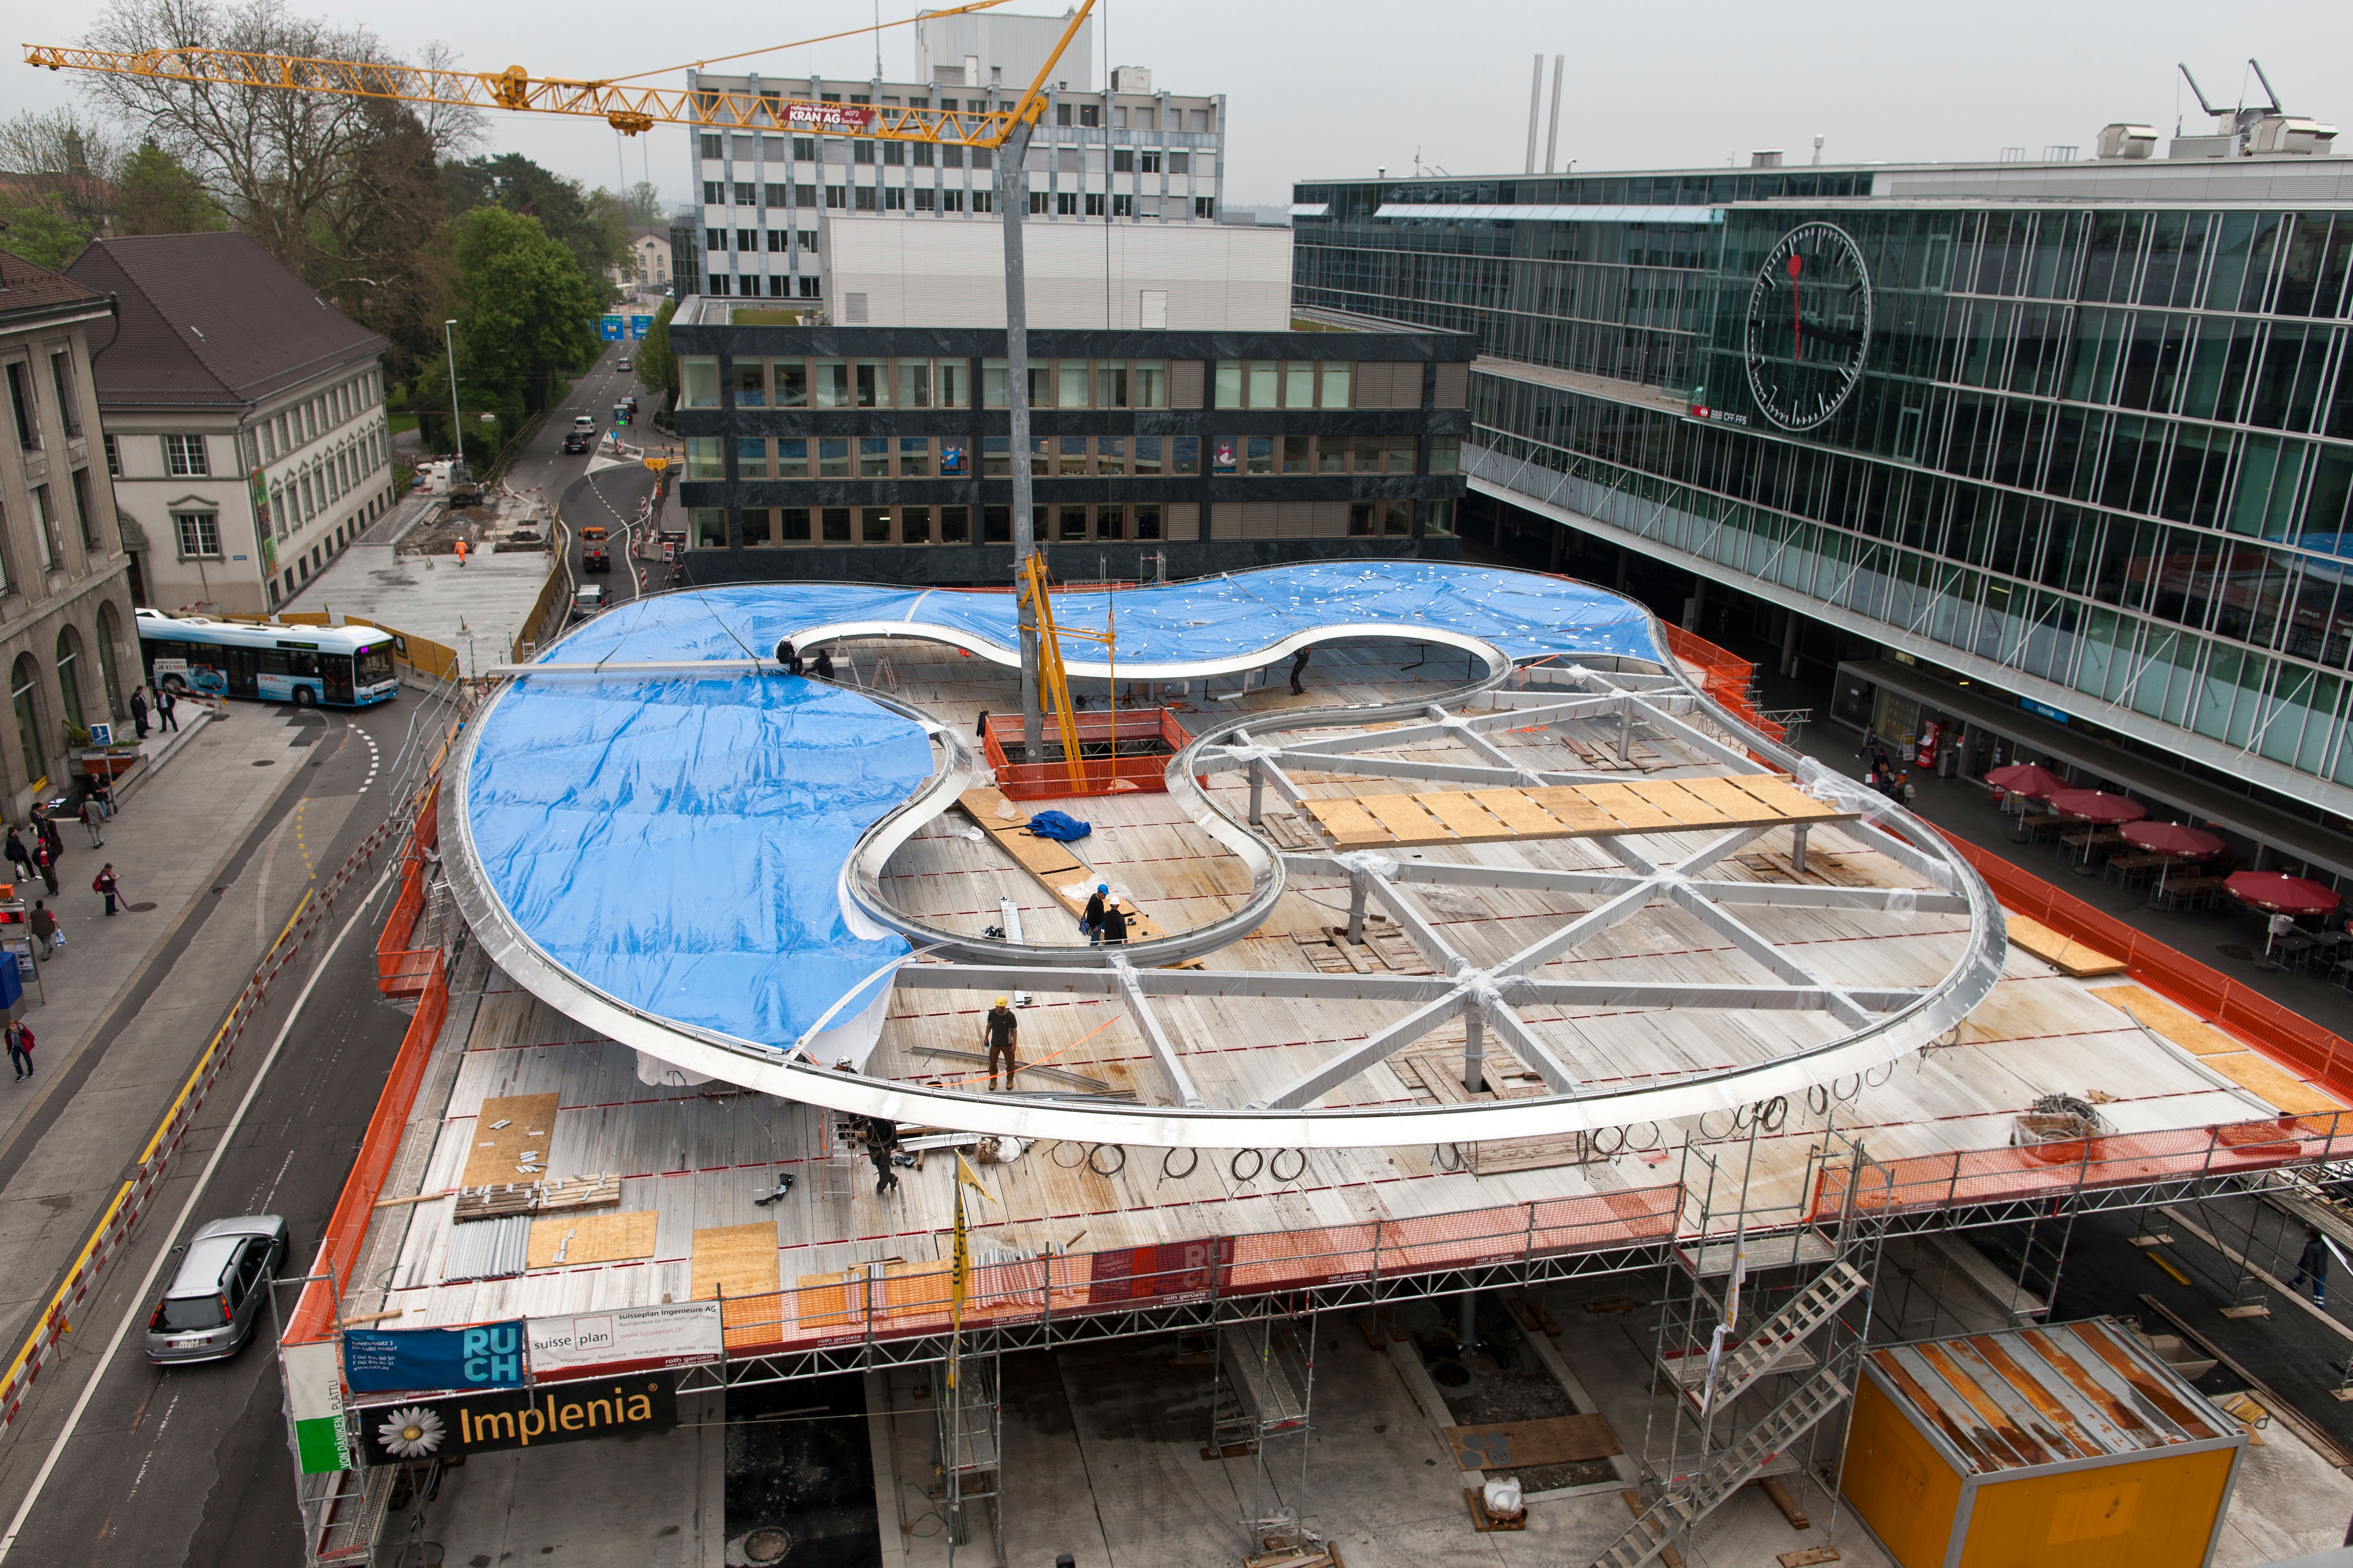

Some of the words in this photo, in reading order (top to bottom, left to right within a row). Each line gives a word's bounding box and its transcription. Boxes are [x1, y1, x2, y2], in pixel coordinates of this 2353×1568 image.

[790, 110, 821, 123] KRAN
[823, 113, 841, 124] AG
[1710, 410, 1722, 419] SBB
[1723, 412, 1735, 422] CFF
[1736, 415, 1747, 425] FFS
[2038, 705, 2054, 717] kiosk
[1179, 1292, 1206, 1300] gerüste
[619, 1311, 660, 1320] suisseplan
[661, 1307, 703, 1316] Ingenieure
[619, 1327, 683, 1339] www.suisseplan.ch
[834, 1335, 861, 1343] gerüste
[534, 1336, 571, 1349] suisse
[580, 1333, 608, 1346] plan
[560, 1356, 591, 1364] Hägglingen
[684, 1354, 714, 1363] gerüste
[328, 1379, 341, 1410] PLÄTTLI
[460, 1387, 651, 1445] Implenia
[333, 1417, 348, 1450] DÄNIKEN
[338, 1451, 349, 1469] VON
